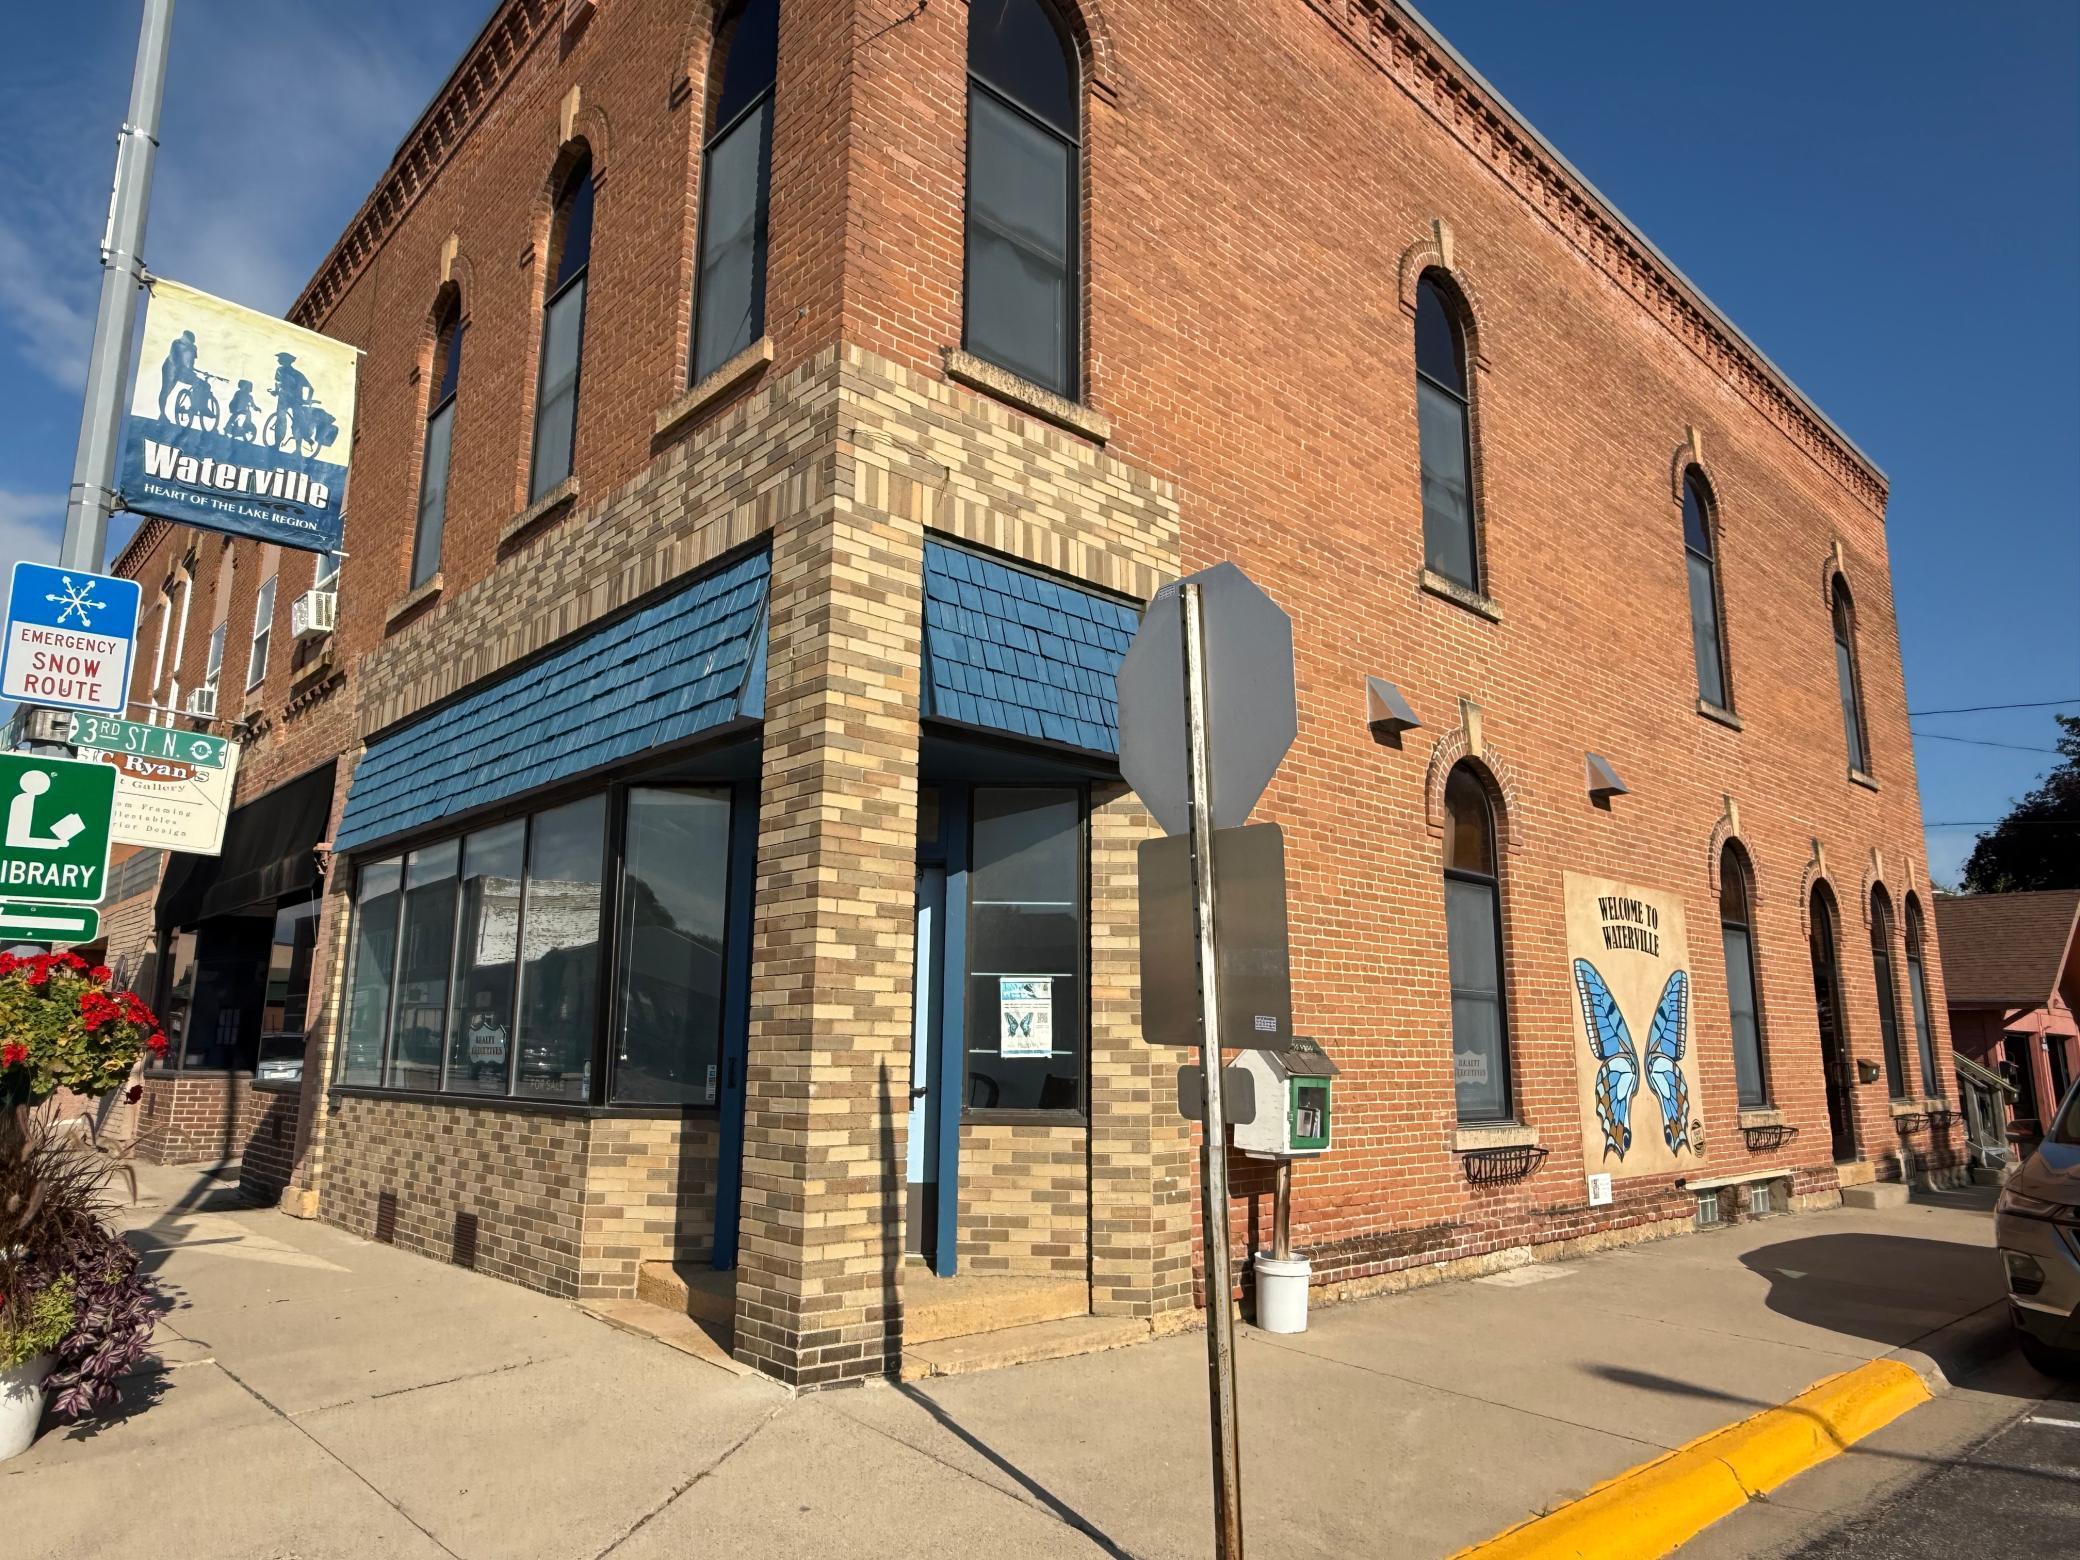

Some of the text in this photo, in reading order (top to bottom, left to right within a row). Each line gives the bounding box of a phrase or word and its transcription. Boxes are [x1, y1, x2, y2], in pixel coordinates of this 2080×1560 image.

[144, 438, 329, 510] Waterville
[144, 483, 318, 531] HEART OF THE LAKE REGION
[21, 628, 117, 655] EMERGENCY
[32, 651, 101, 678] SNOW
[24, 673, 102, 702] ROUTE
[83, 718, 180, 759] 3RD ST. N.
[124, 754, 210, 783] Ryan's
[132, 780, 187, 793] Gallery
[141, 803, 191, 818] Framing
[146, 825, 187, 837] Design
[0, 860, 96, 888] IBRARY
[1598, 896, 1658, 930] WELCOME TO
[1601, 925, 1660, 958] WATERVILLE
